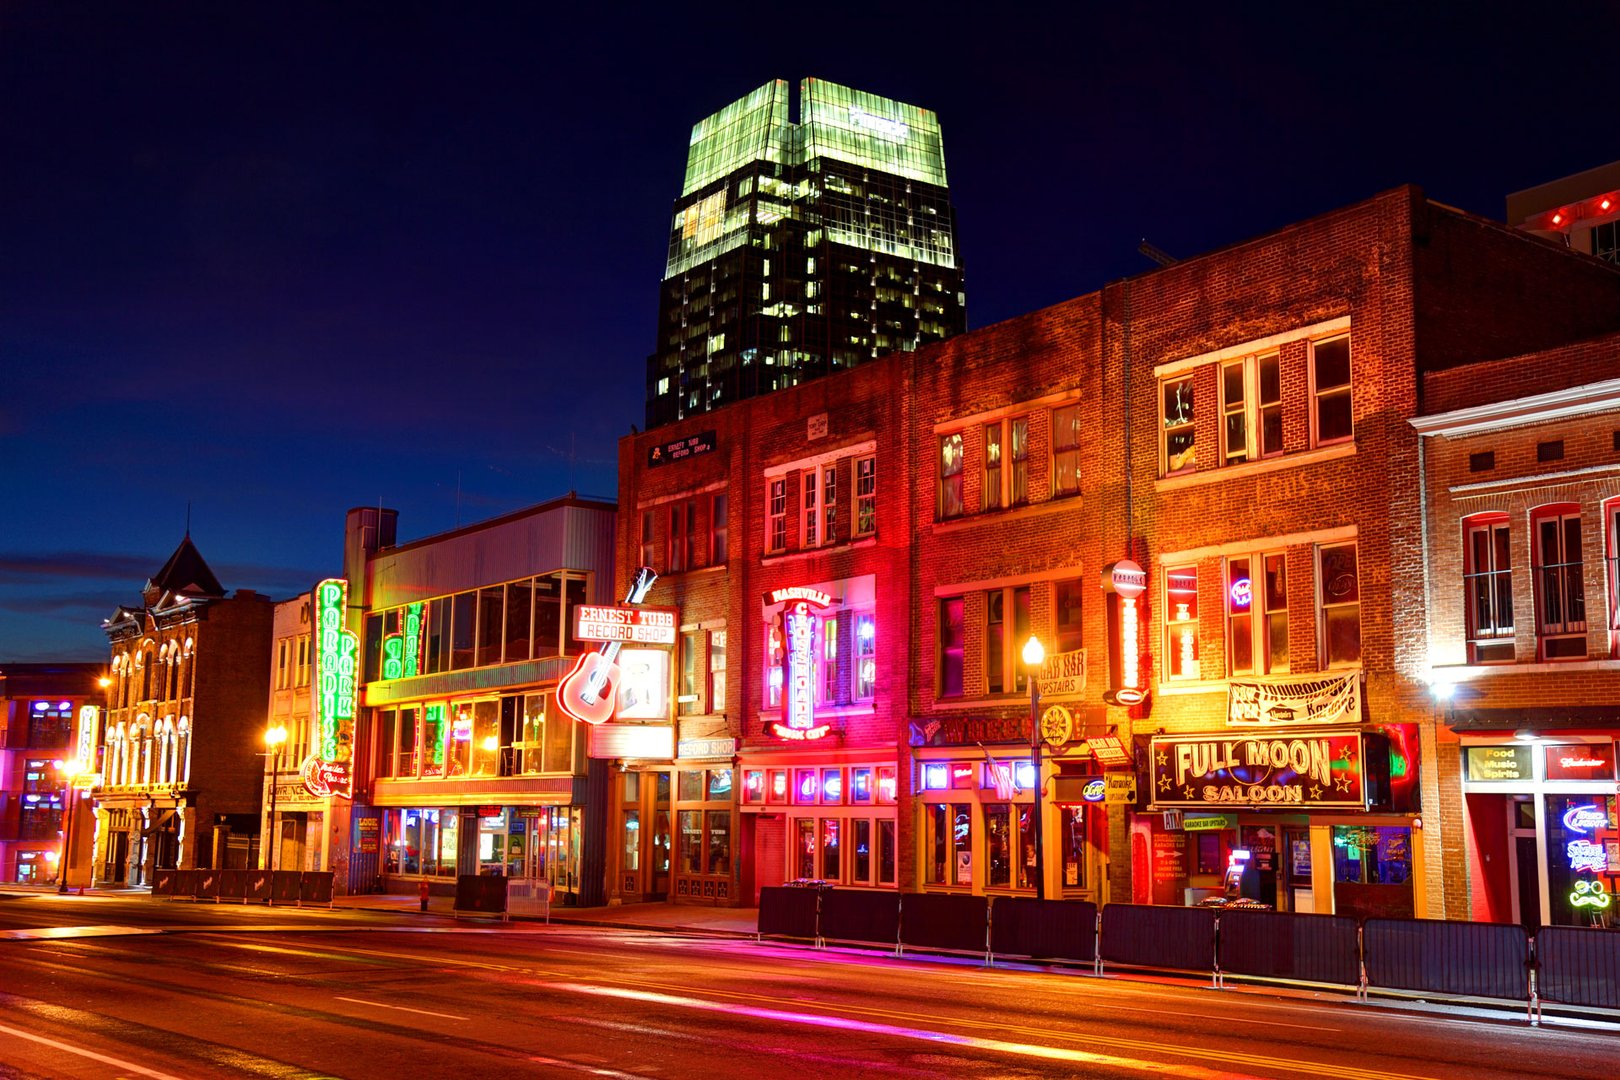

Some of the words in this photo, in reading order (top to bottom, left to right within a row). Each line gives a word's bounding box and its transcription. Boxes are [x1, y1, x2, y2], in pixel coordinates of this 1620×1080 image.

[772, 587, 832, 606] NASHVILLE
[580, 606, 633, 624] ERNEST
[639, 611, 673, 627] TUBB
[587, 624, 632, 639] RECORD
[637, 628, 667, 641] SHOP
[322, 585, 341, 761] PARADISE
[1063, 651, 1084, 678] BAR
[337, 634, 355, 717] PARK
[710, 740, 732, 754] SHOP
[1486, 749, 1515, 758] Food
[1175, 742, 1240, 787] FULL
[1246, 739, 1331, 788] MOON
[1484, 760, 1517, 769] Music
[1483, 769, 1519, 779] Spirits
[269, 785, 304, 796] LWRNCE
[1203, 784, 1303, 803] SALOON
[1165, 811, 1183, 830] ATM
